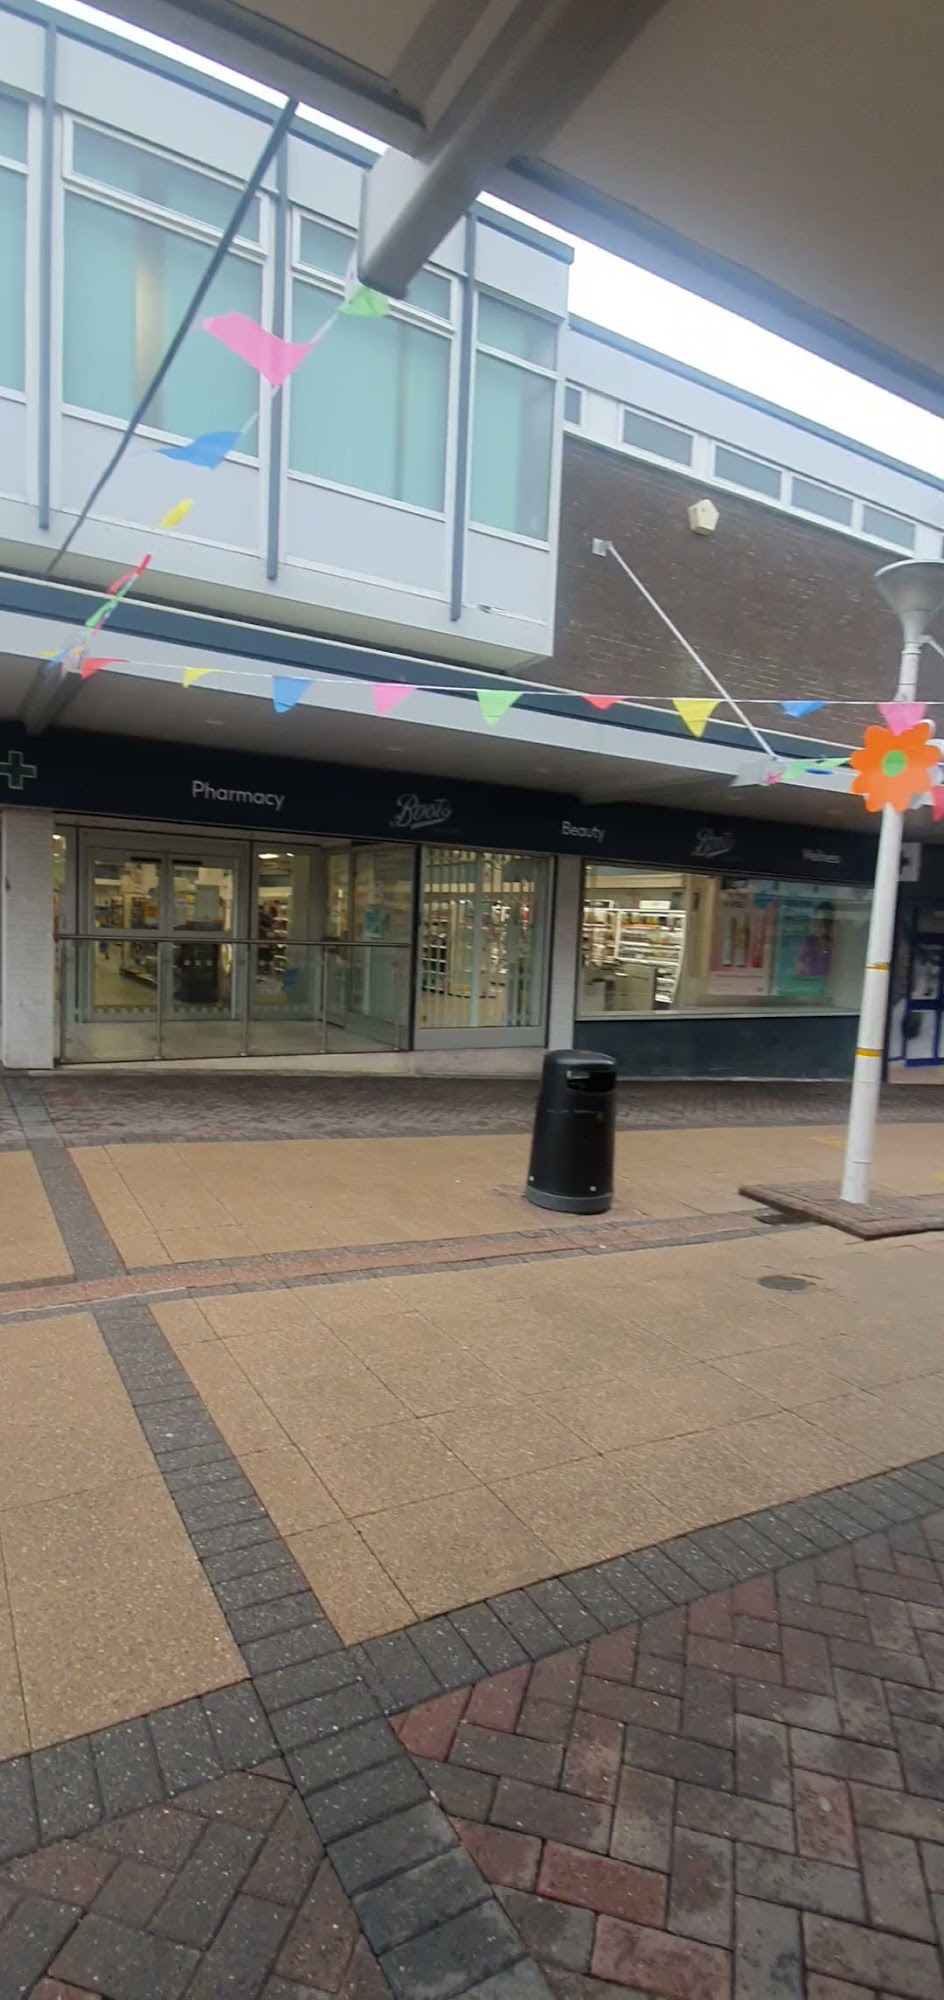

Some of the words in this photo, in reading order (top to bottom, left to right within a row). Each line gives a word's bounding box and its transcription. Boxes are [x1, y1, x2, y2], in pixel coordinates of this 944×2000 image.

[191, 780, 285, 812] Pharmacy
[388, 793, 453, 829] Boots
[561, 820, 606, 843] Beauty
